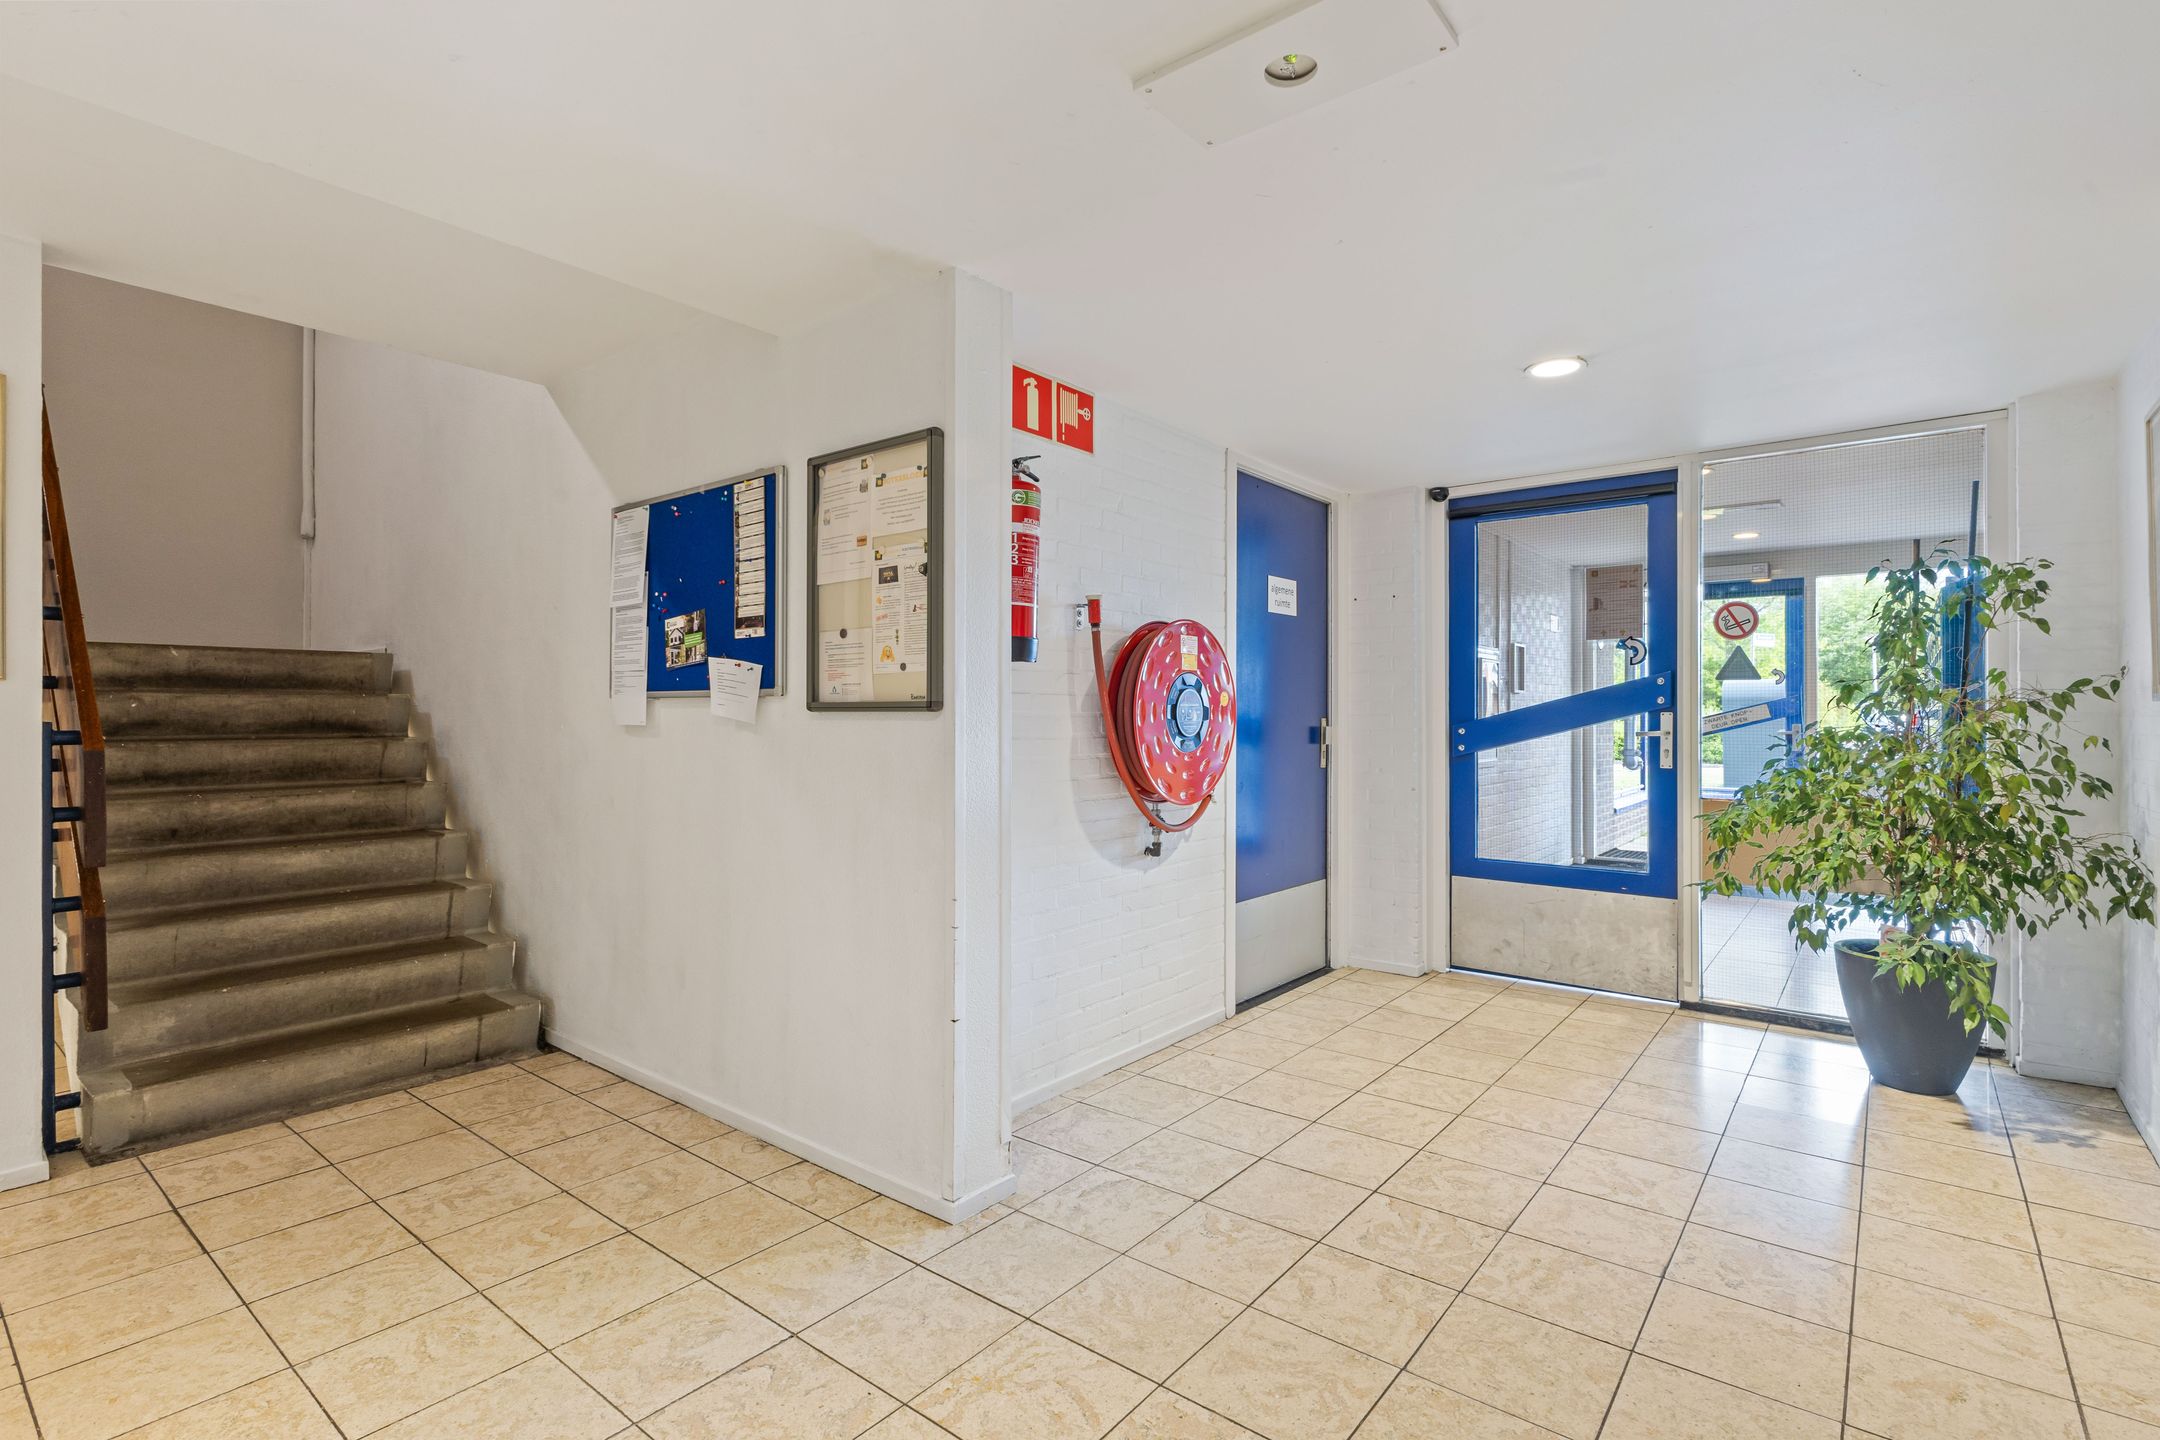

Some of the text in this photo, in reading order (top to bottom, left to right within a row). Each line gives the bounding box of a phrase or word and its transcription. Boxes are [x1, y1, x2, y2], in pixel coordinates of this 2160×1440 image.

[1012, 532, 1018, 544] 1
[1012, 543, 1019, 554] 2
[1012, 554, 1019, 565] 3
[1271, 583, 1295, 597] algemene
[1274, 599, 1291, 608] ruimte
[1703, 715, 1728, 725] ZWARTE
[1711, 717, 1748, 729] DEUR OPEN
